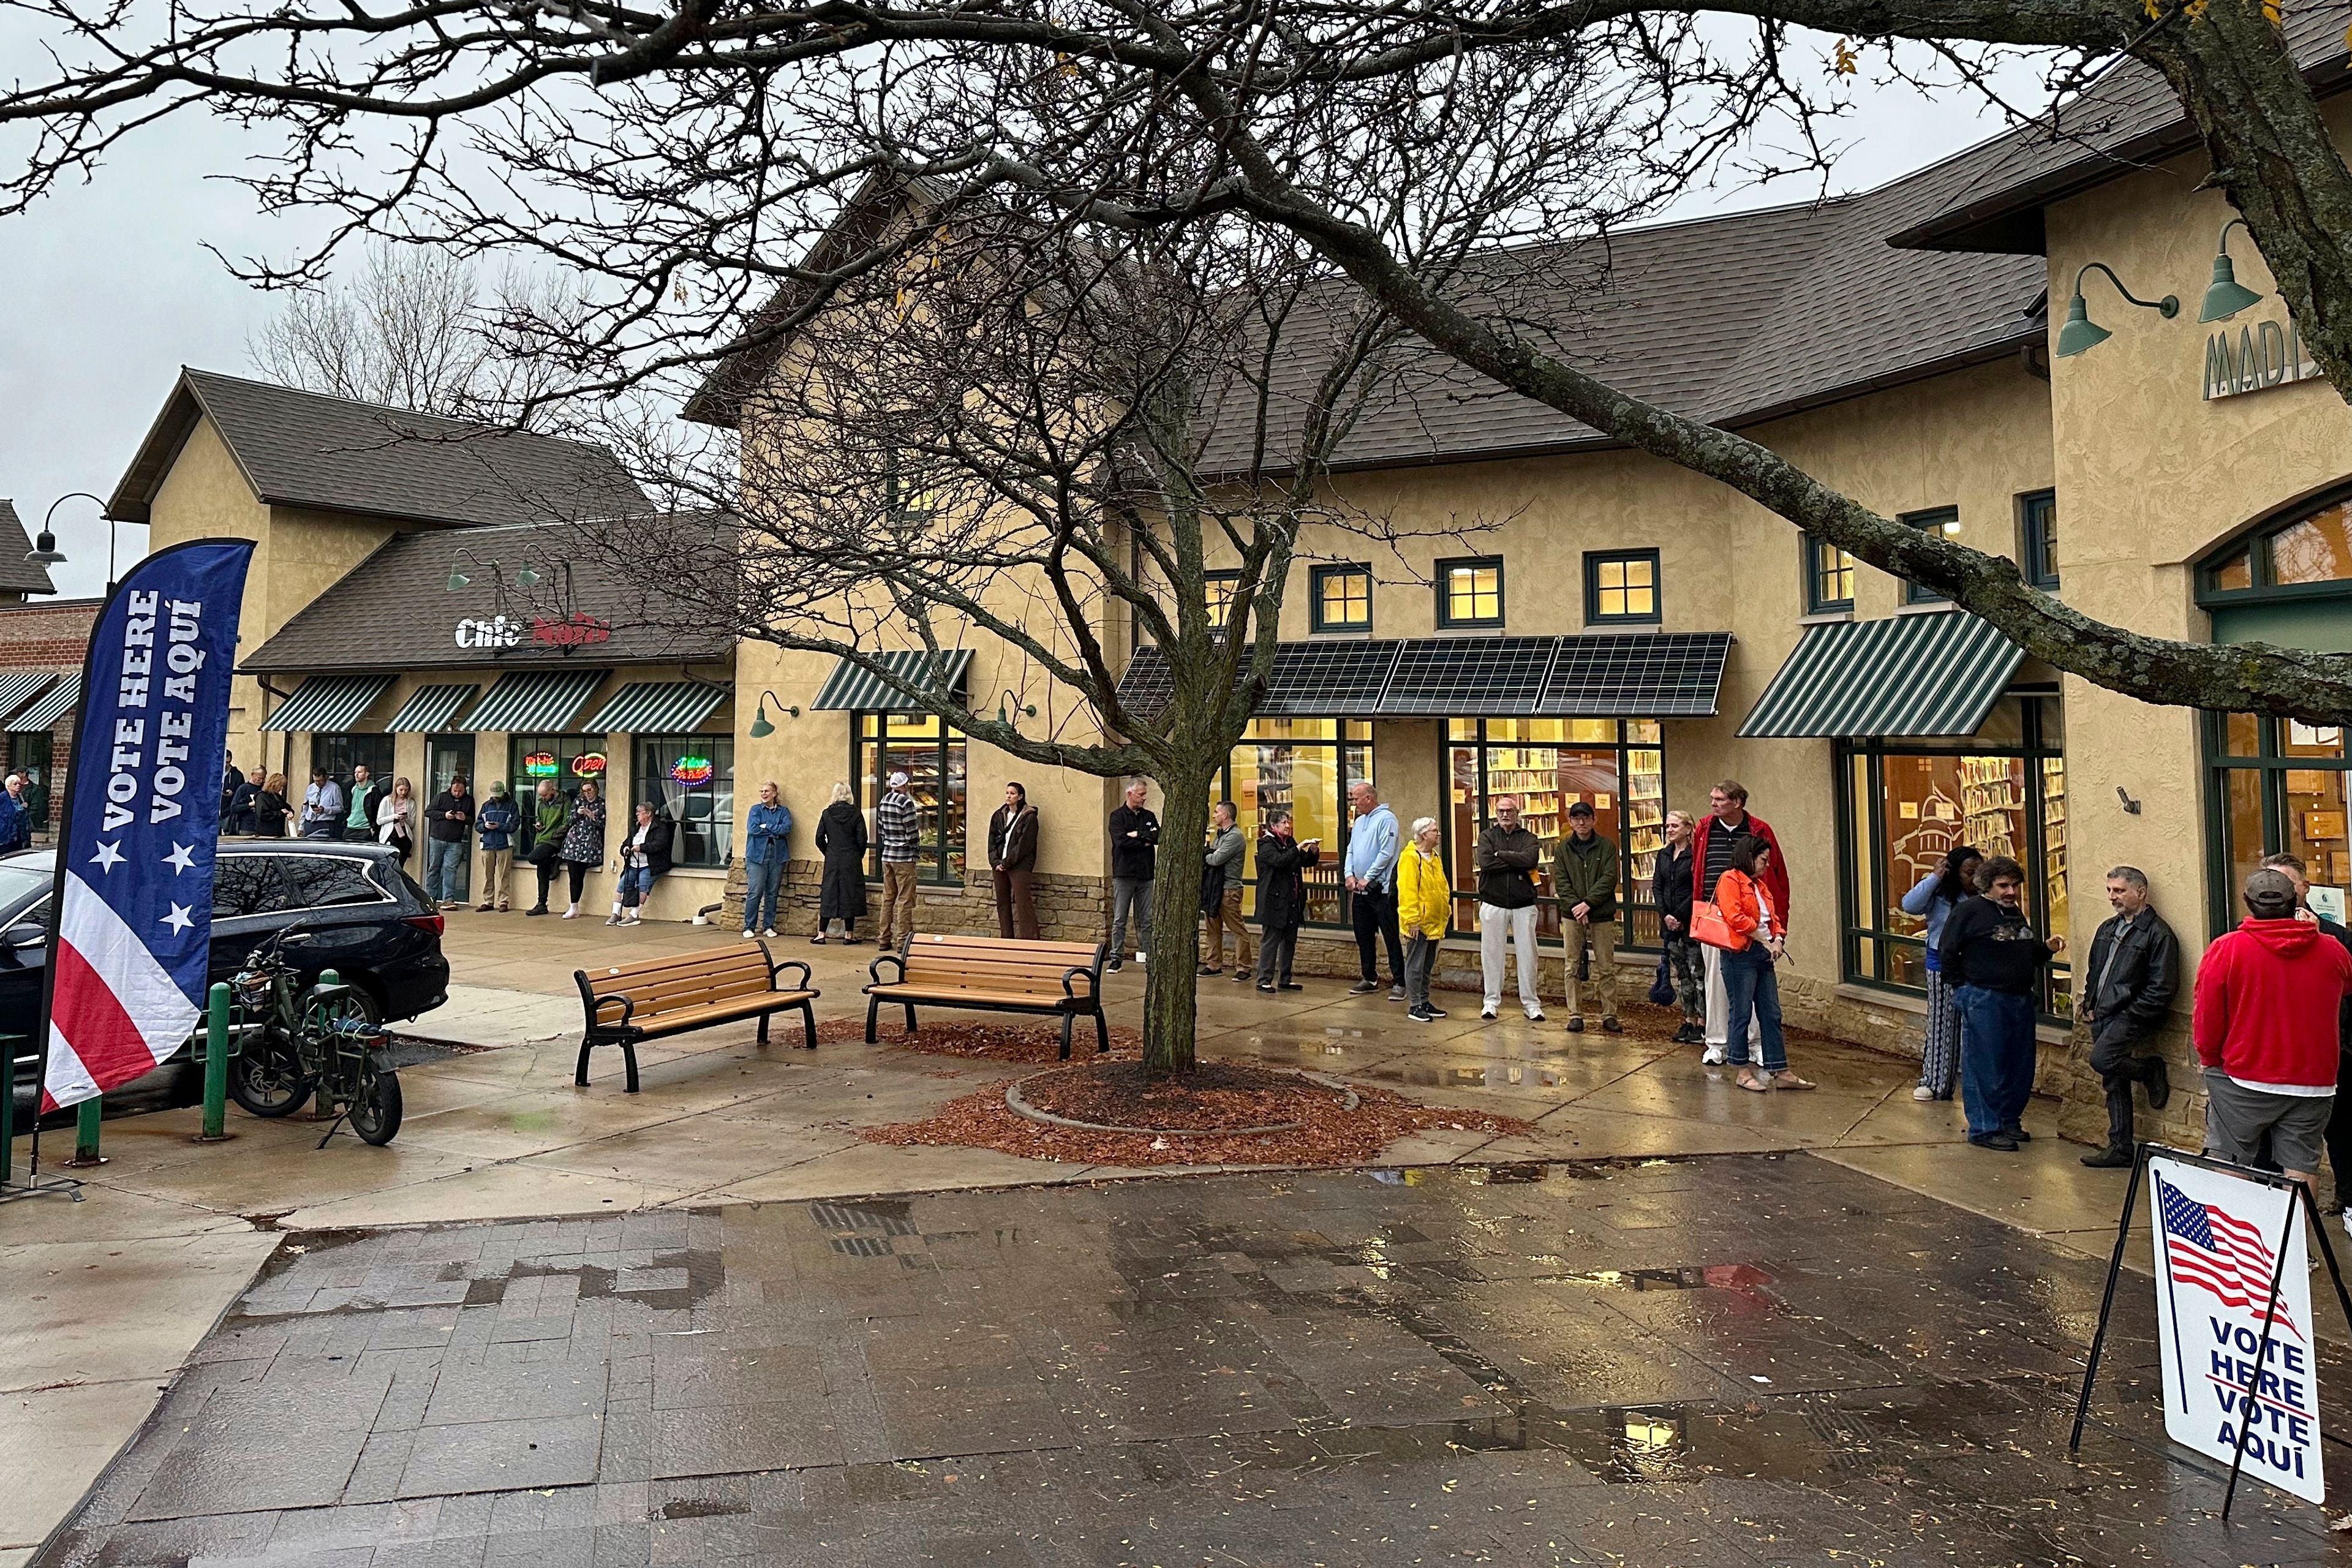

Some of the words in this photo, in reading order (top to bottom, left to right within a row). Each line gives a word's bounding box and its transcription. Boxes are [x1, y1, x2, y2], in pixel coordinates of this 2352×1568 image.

[2203, 318, 2320, 401] MADI
[119, 590, 159, 707] HERE
[164, 599, 206, 703] AQUÍ
[455, 615, 520, 648] Chic
[103, 719, 145, 831] VOTE
[150, 712, 192, 823] VOTE
[573, 756, 606, 772] Open
[2209, 1316, 2305, 1375] VOTE
[2211, 1349, 2305, 1410] HERE
[2214, 1383, 2310, 1447] VOTE
[2217, 1420, 2304, 1480] AQUÍ
